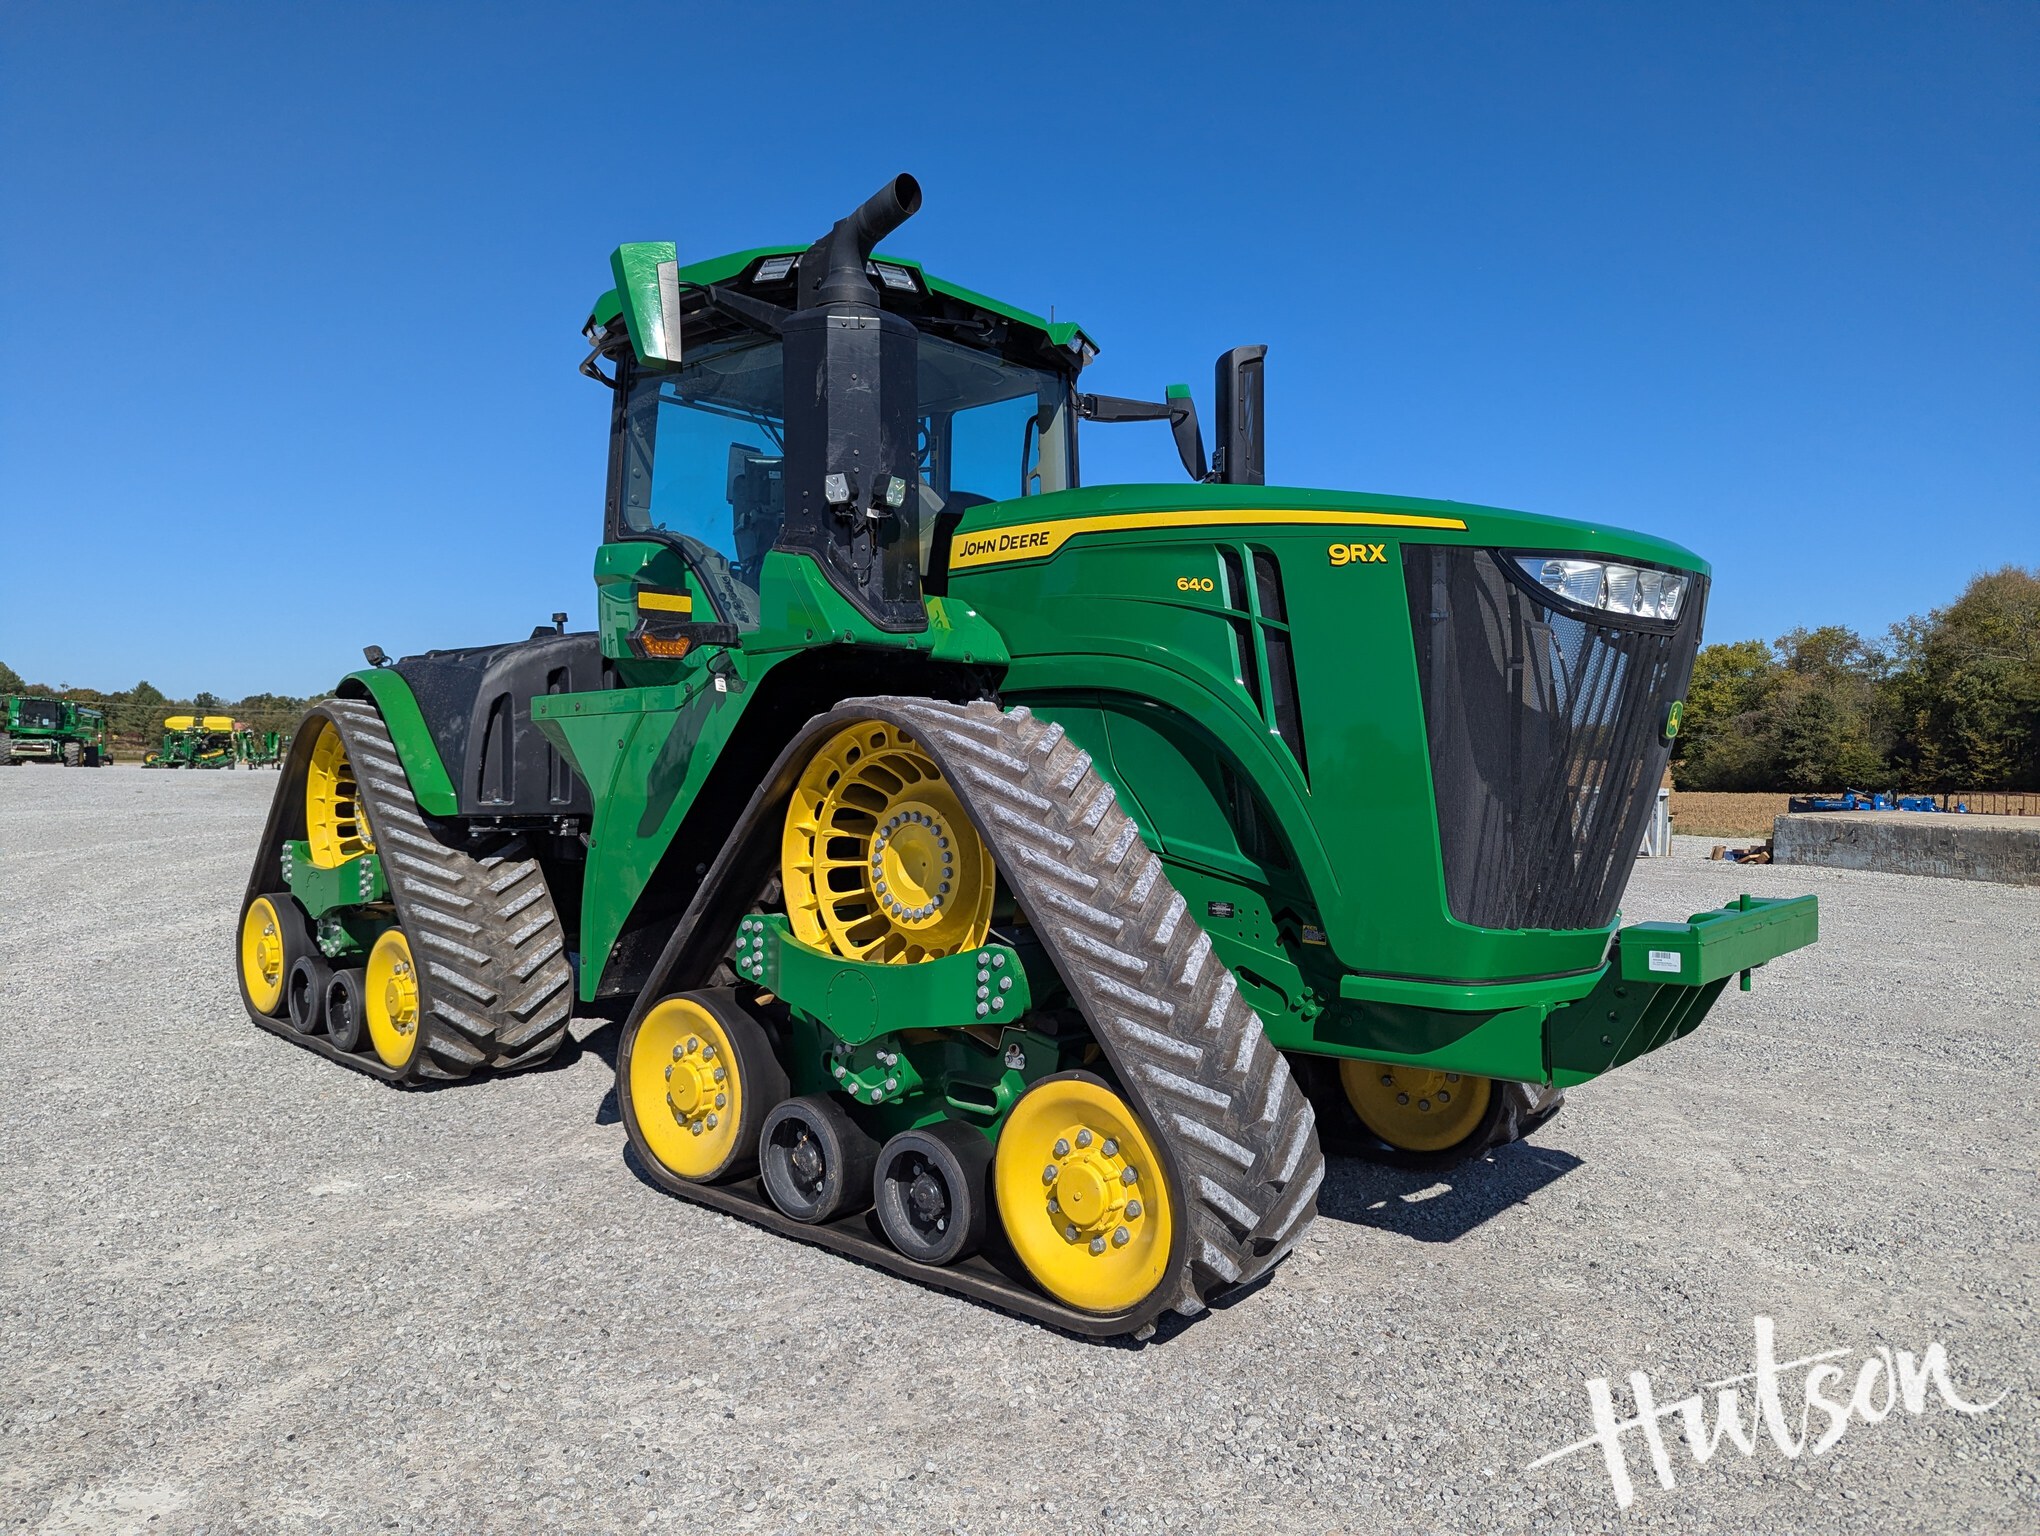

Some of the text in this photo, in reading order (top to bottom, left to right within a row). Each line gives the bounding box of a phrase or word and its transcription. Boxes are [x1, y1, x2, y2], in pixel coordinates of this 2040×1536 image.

[959, 530, 1051, 558] JOHN DEERE
[1327, 543, 1388, 567] 9RX
[1176, 576, 1215, 593] 640
